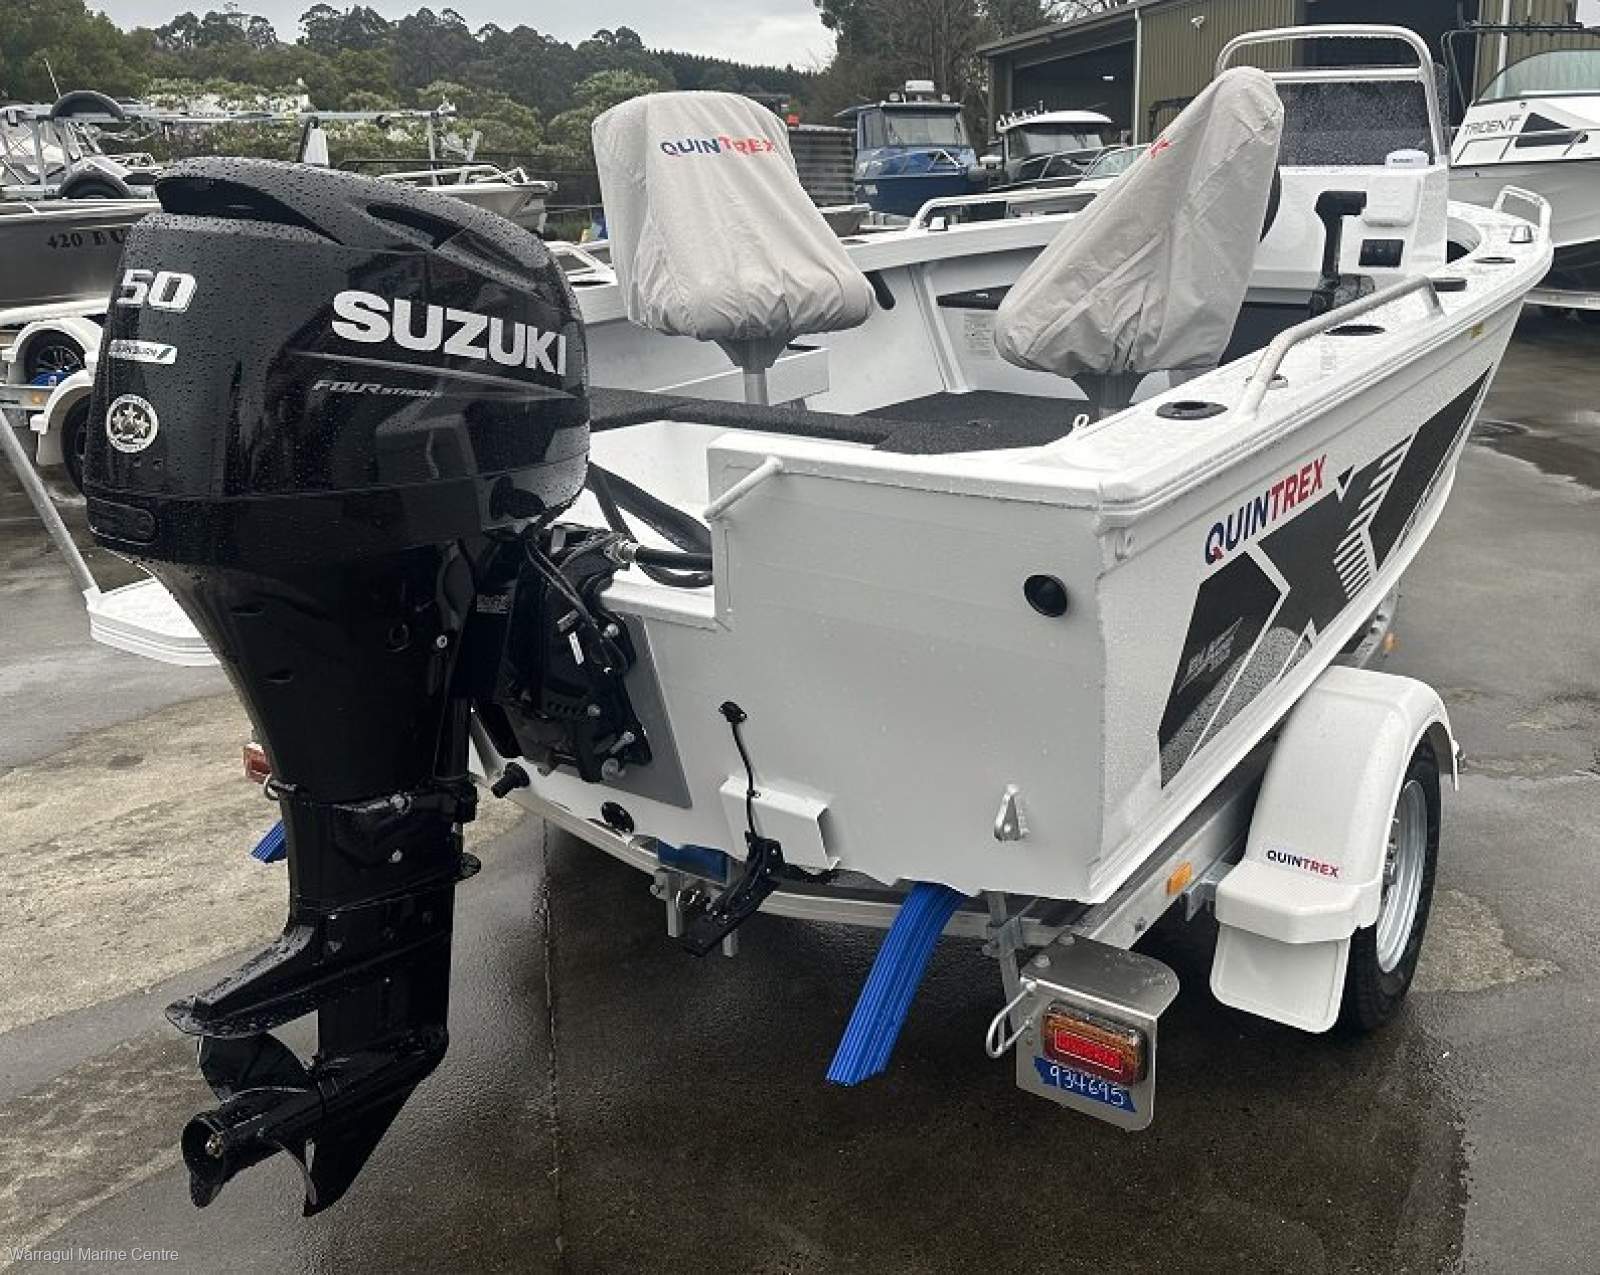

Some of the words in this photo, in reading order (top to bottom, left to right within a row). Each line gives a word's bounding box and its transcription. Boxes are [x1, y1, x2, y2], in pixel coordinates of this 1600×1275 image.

[1464, 114, 1521, 135] TRIDENT
[660, 136, 776, 157] QUINTREX
[47, 232, 83, 249] 420
[116, 269, 198, 312] 50
[331, 290, 567, 376] SUZUKI
[1205, 454, 1327, 565] QUINTREX
[1267, 850, 1339, 878] QUINTREX
